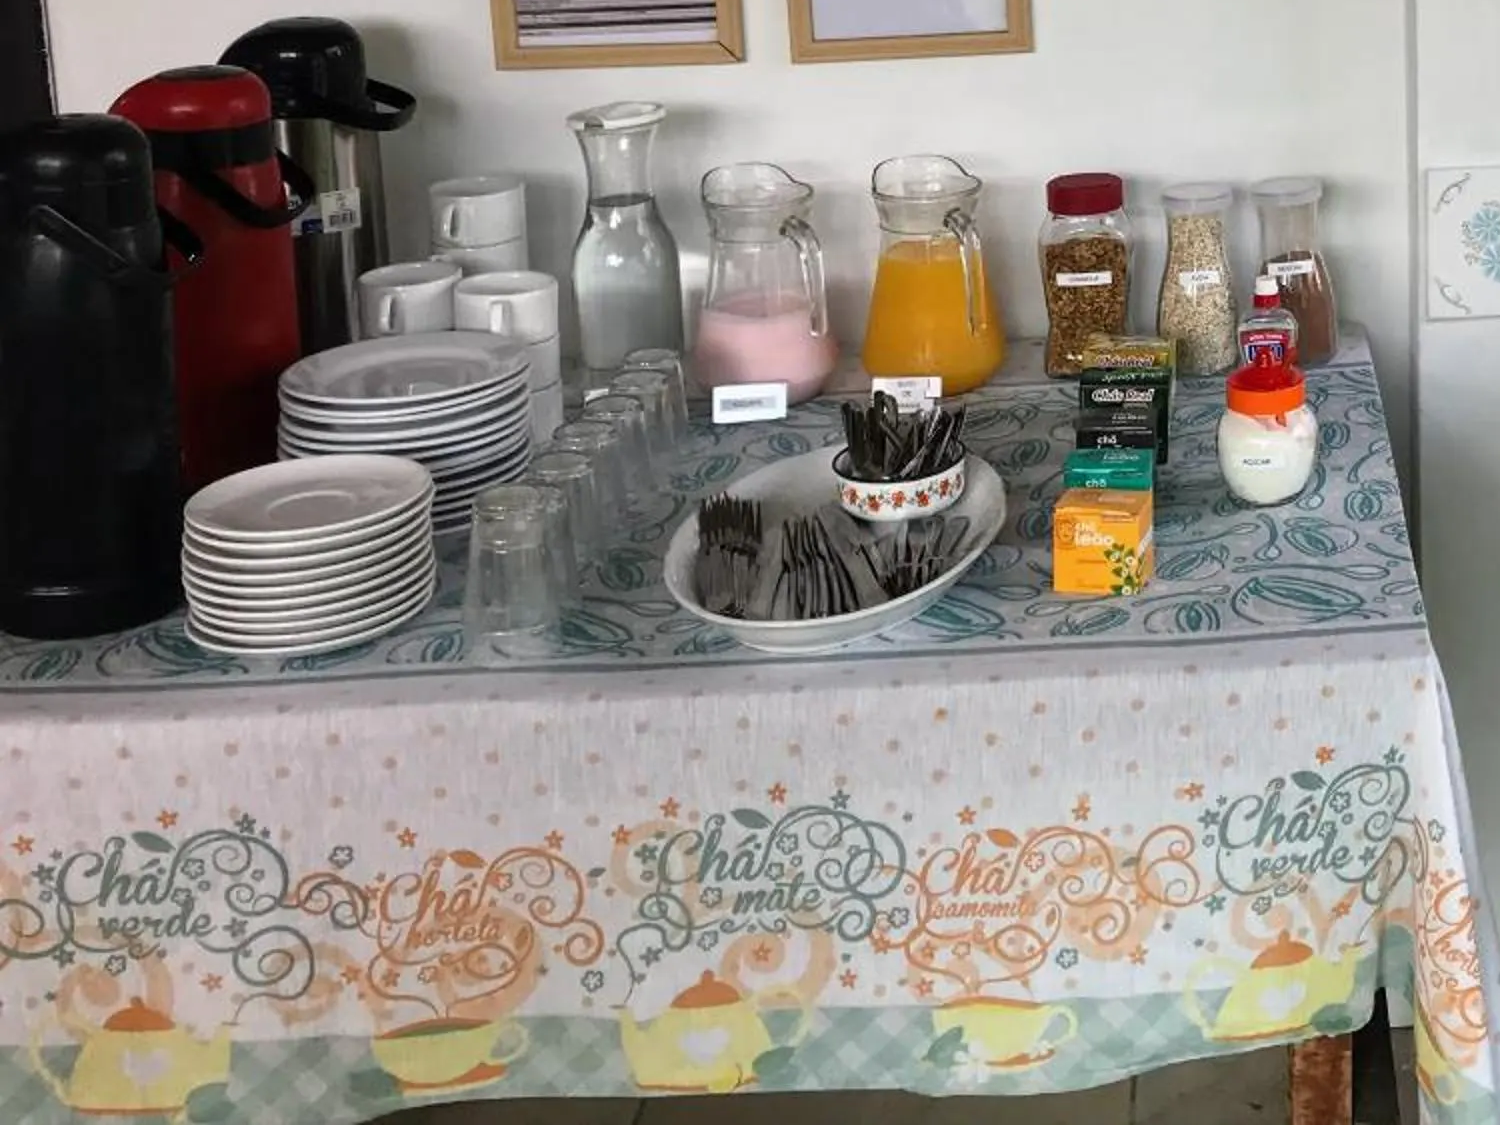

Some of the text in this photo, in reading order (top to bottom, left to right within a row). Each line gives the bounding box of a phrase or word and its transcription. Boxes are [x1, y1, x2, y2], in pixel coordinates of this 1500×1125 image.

[1218, 777, 1321, 848] Chá
[57, 836, 170, 907] Chá
[658, 813, 763, 885] Chá
[921, 832, 1012, 896] Chá
[1250, 830, 1353, 878] verde
[97, 896, 217, 940] verde
[380, 855, 480, 923] Chá
[732, 877, 824, 915] mate
